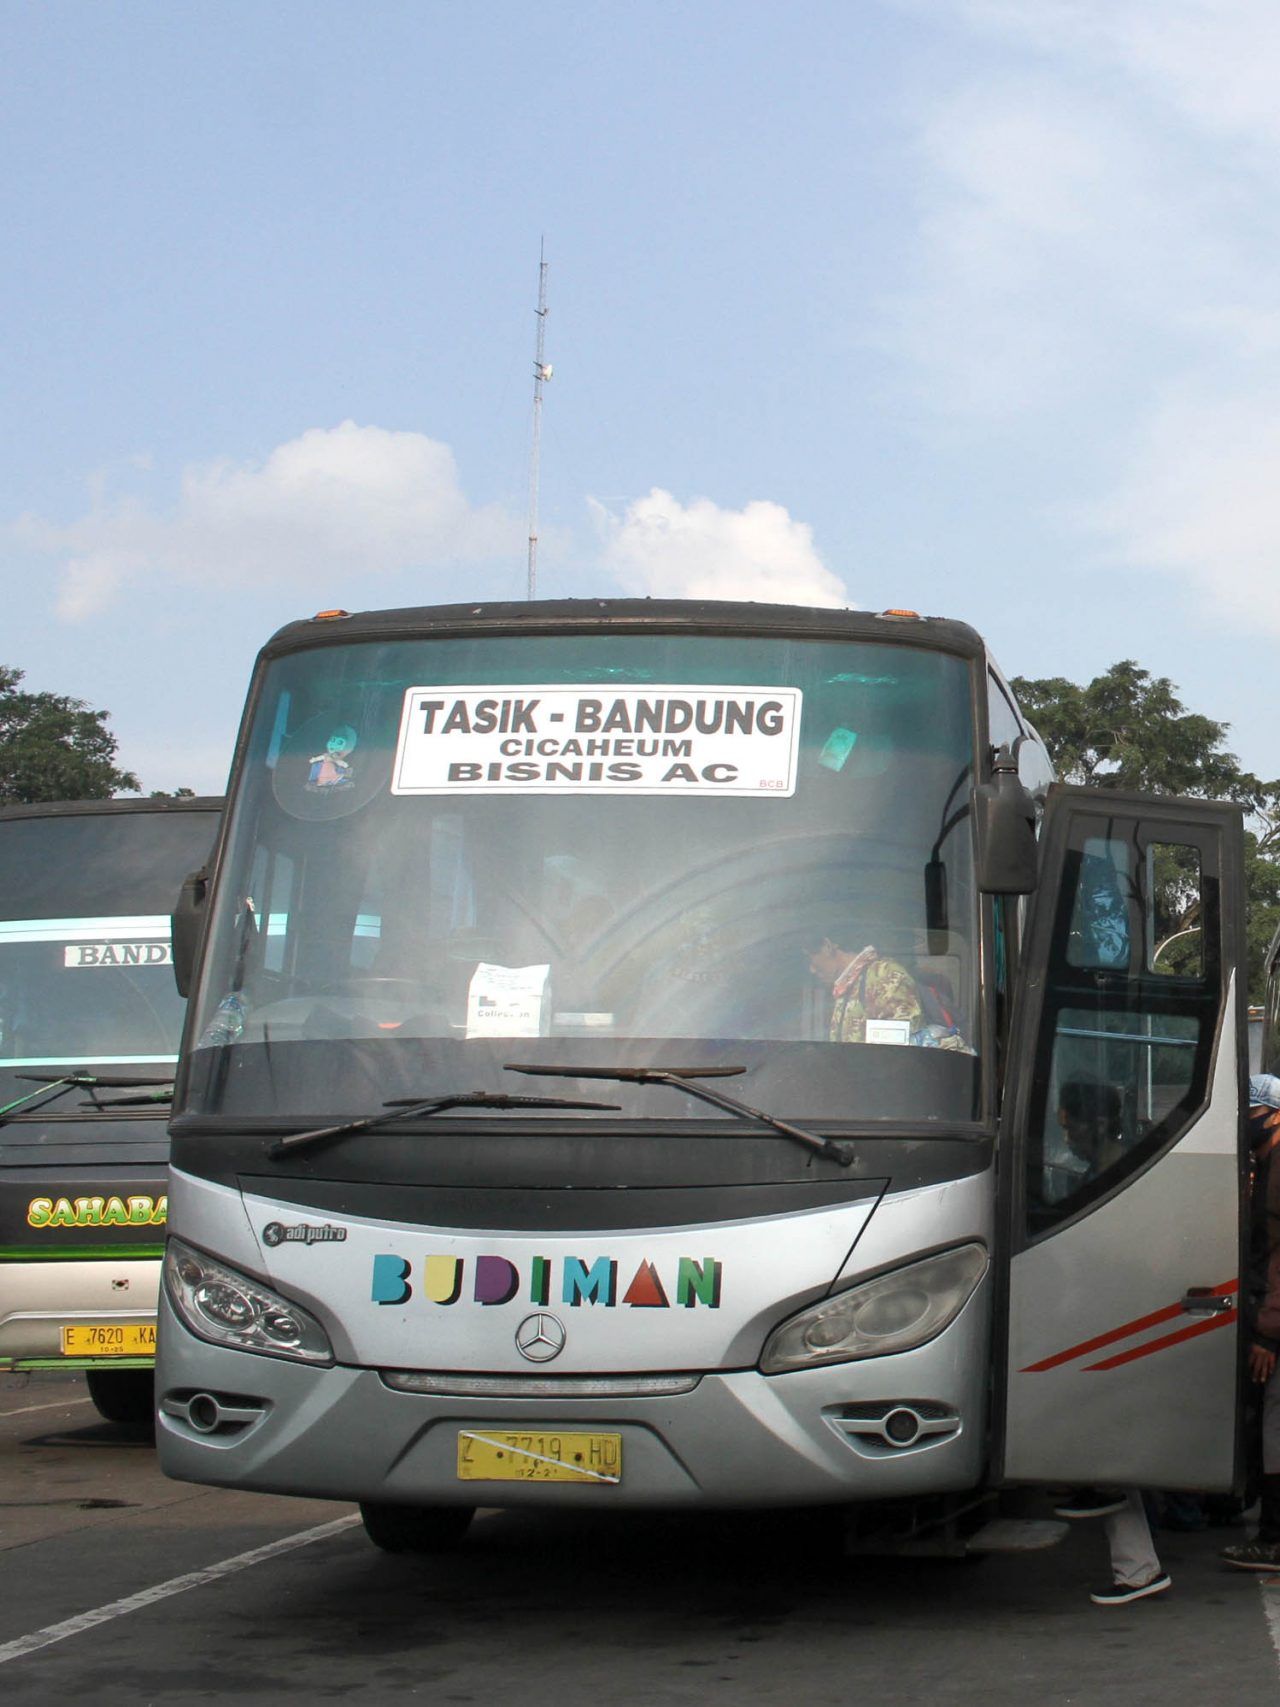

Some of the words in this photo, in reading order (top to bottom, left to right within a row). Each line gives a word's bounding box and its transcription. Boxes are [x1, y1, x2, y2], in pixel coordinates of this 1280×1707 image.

[420, 699, 540, 735] TASIK
[575, 698, 784, 736] BANDUNG
[500, 738, 693, 757] CICAHEUM
[447, 762, 643, 782] BISNIS
[661, 763, 739, 783] AC
[28, 1195, 168, 1228] SAHABA
[371, 1254, 722, 1308] BUDIMAN
[66, 1328, 75, 1345] E
[90, 1327, 124, 1344] 7620
[139, 1327, 157, 1344] KA
[462, 1435, 474, 1463] Z
[506, 1436, 562, 1464] 7719
[589, 1438, 618, 1466] HD
